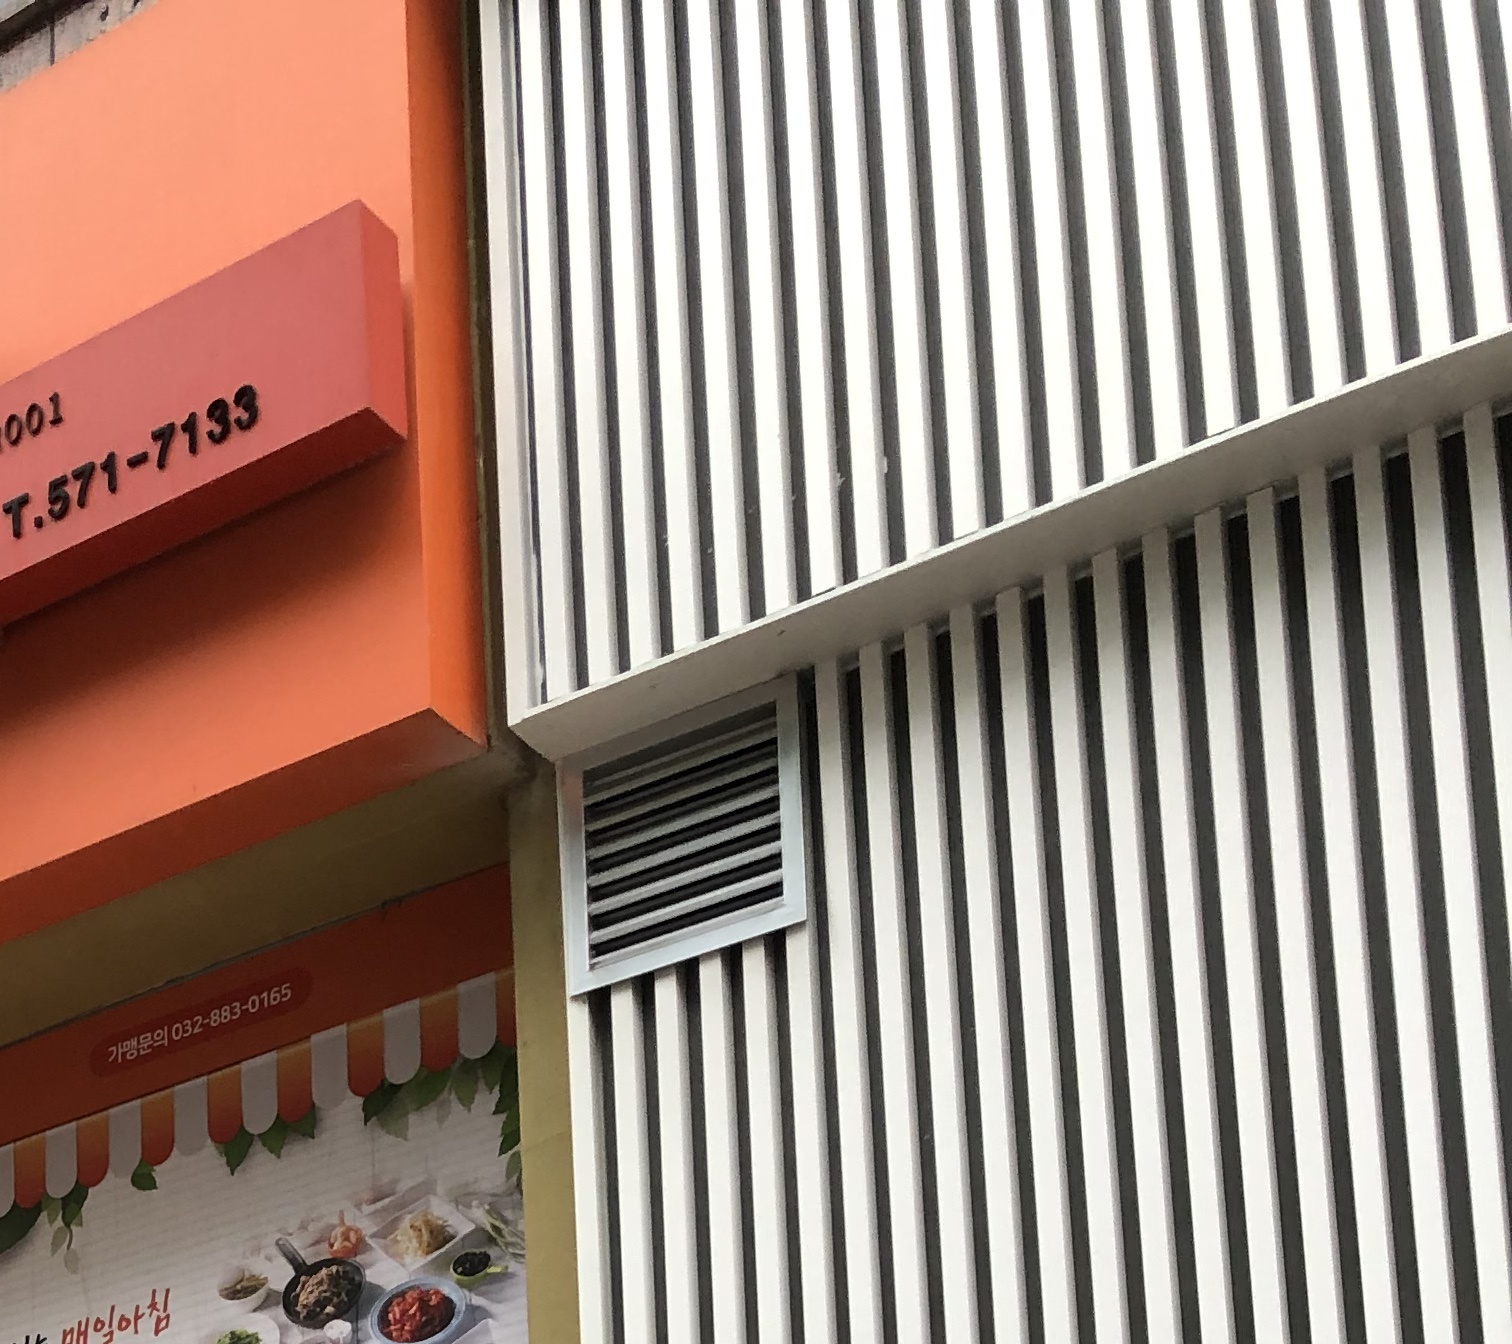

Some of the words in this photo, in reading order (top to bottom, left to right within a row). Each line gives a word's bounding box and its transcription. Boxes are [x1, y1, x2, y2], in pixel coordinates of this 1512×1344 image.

[2, 384, 259, 538] T.571-7133
[107, 1027, 169, 1065] 가맹문의
[171, 982, 293, 1042] 032-883-0165
